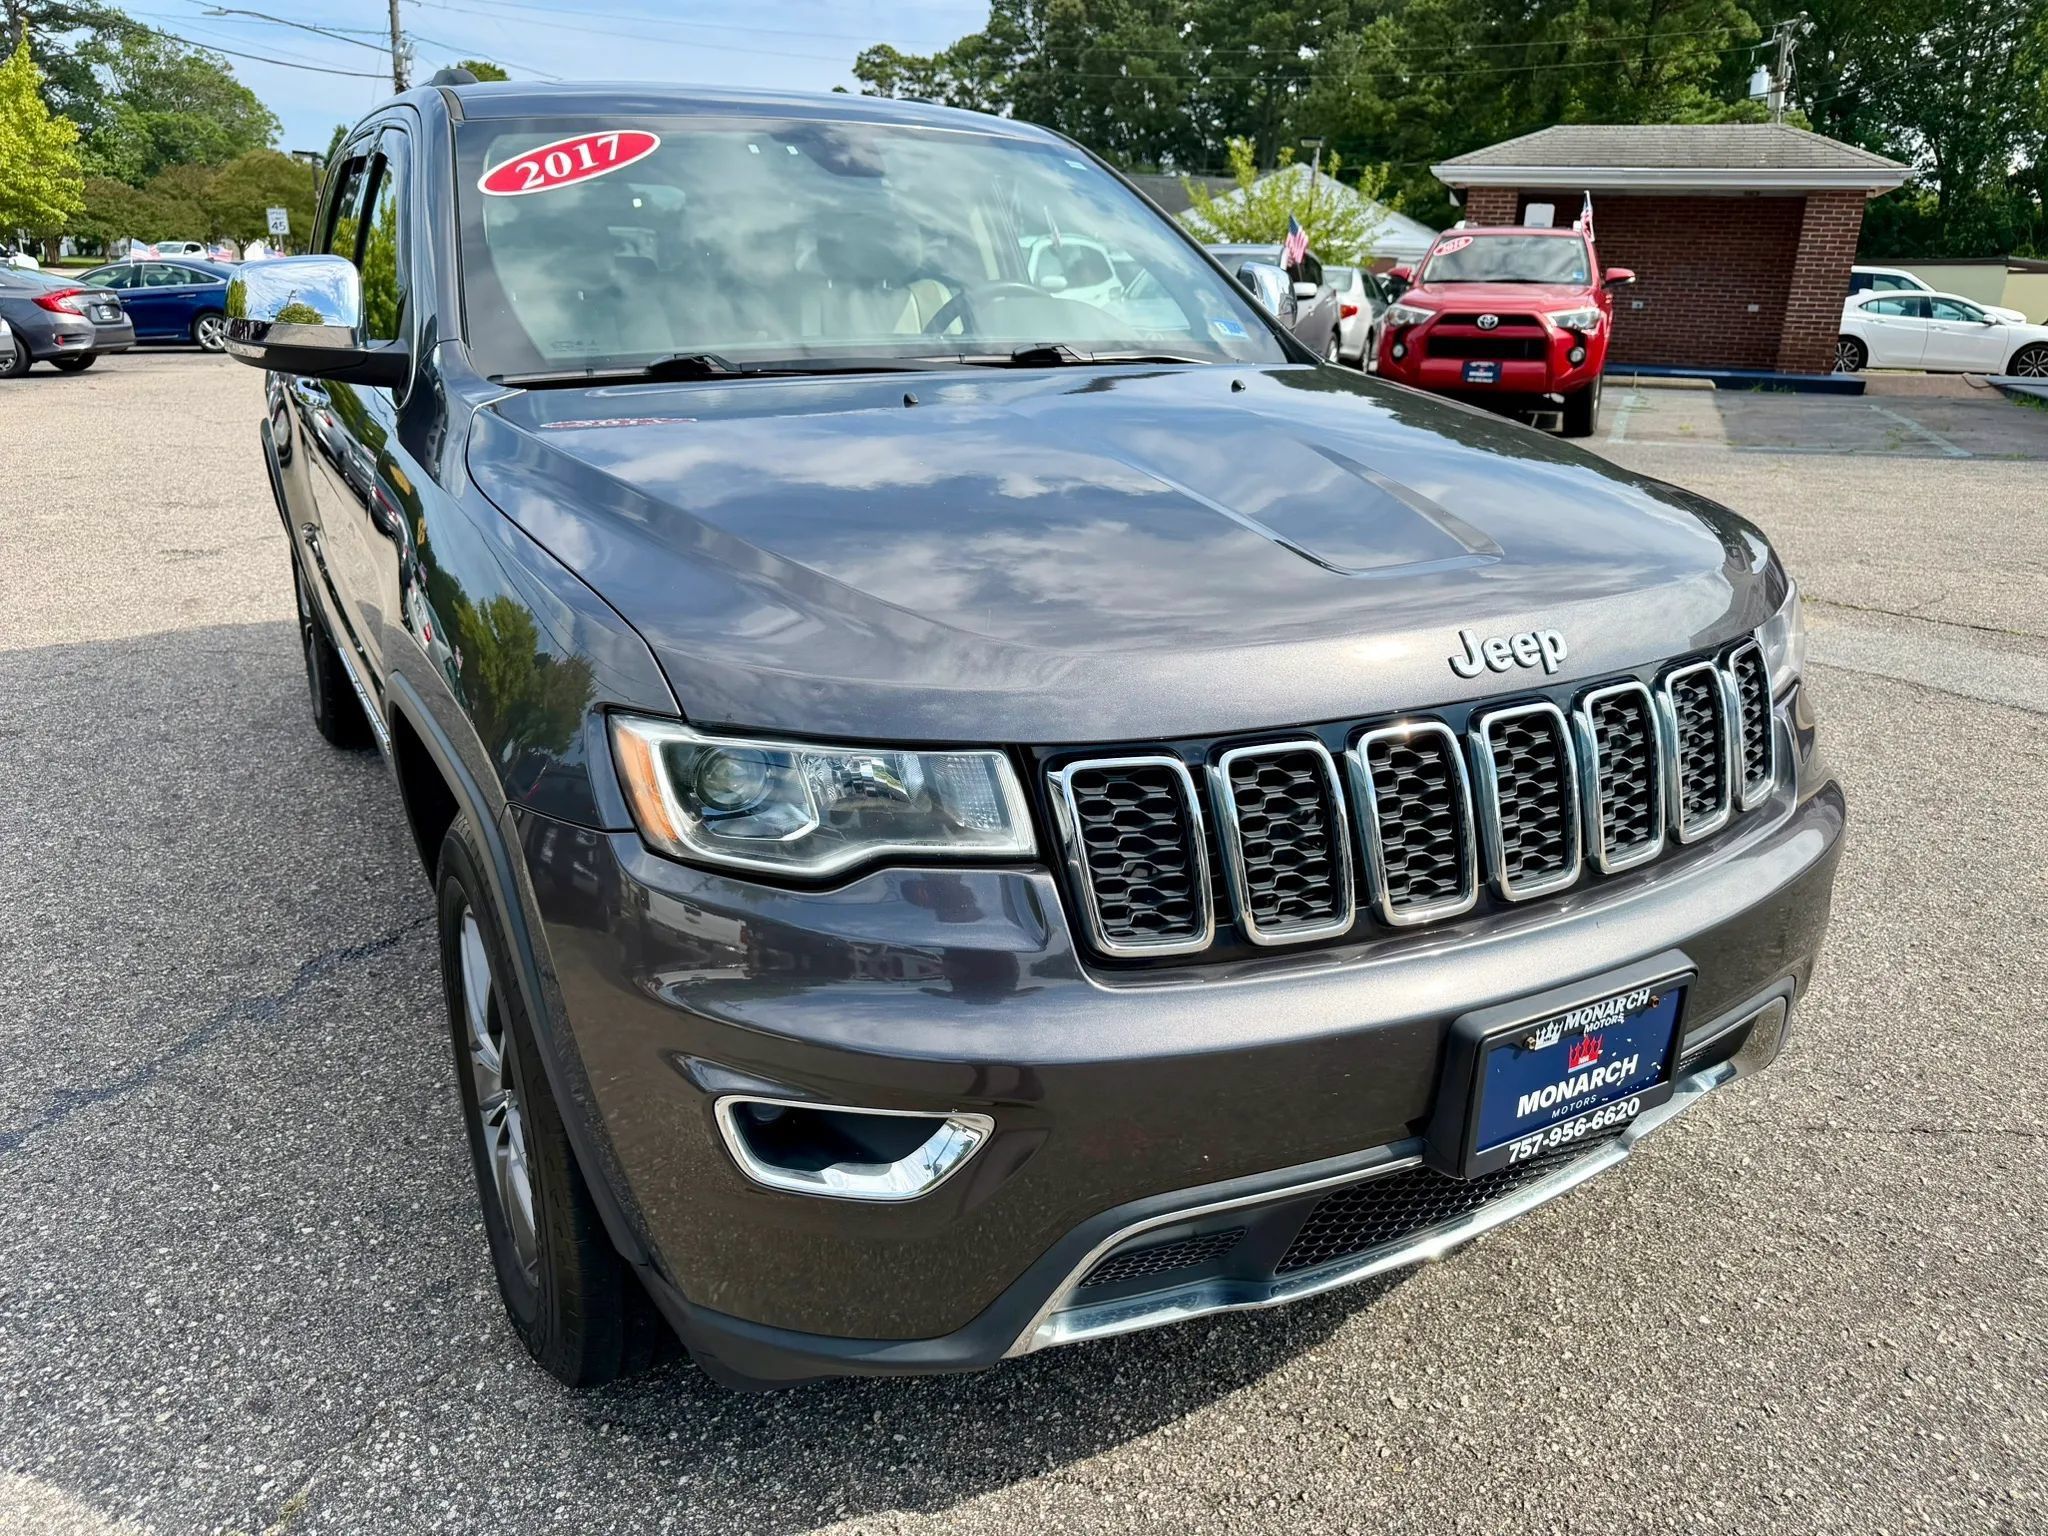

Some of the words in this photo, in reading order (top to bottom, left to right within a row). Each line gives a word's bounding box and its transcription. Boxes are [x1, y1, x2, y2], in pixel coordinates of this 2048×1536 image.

[515, 133, 619, 189] 2017
[271, 221, 286, 231] 45
[1448, 629, 1567, 679] Jeep
[1564, 987, 1651, 1031] MONARCH
[1584, 1013, 1624, 1034] MOTORS
[1517, 1054, 1639, 1118] MONARCH
[1552, 1095, 1597, 1118] MOTORS
[1509, 1097, 1640, 1163] 757-956-6620
